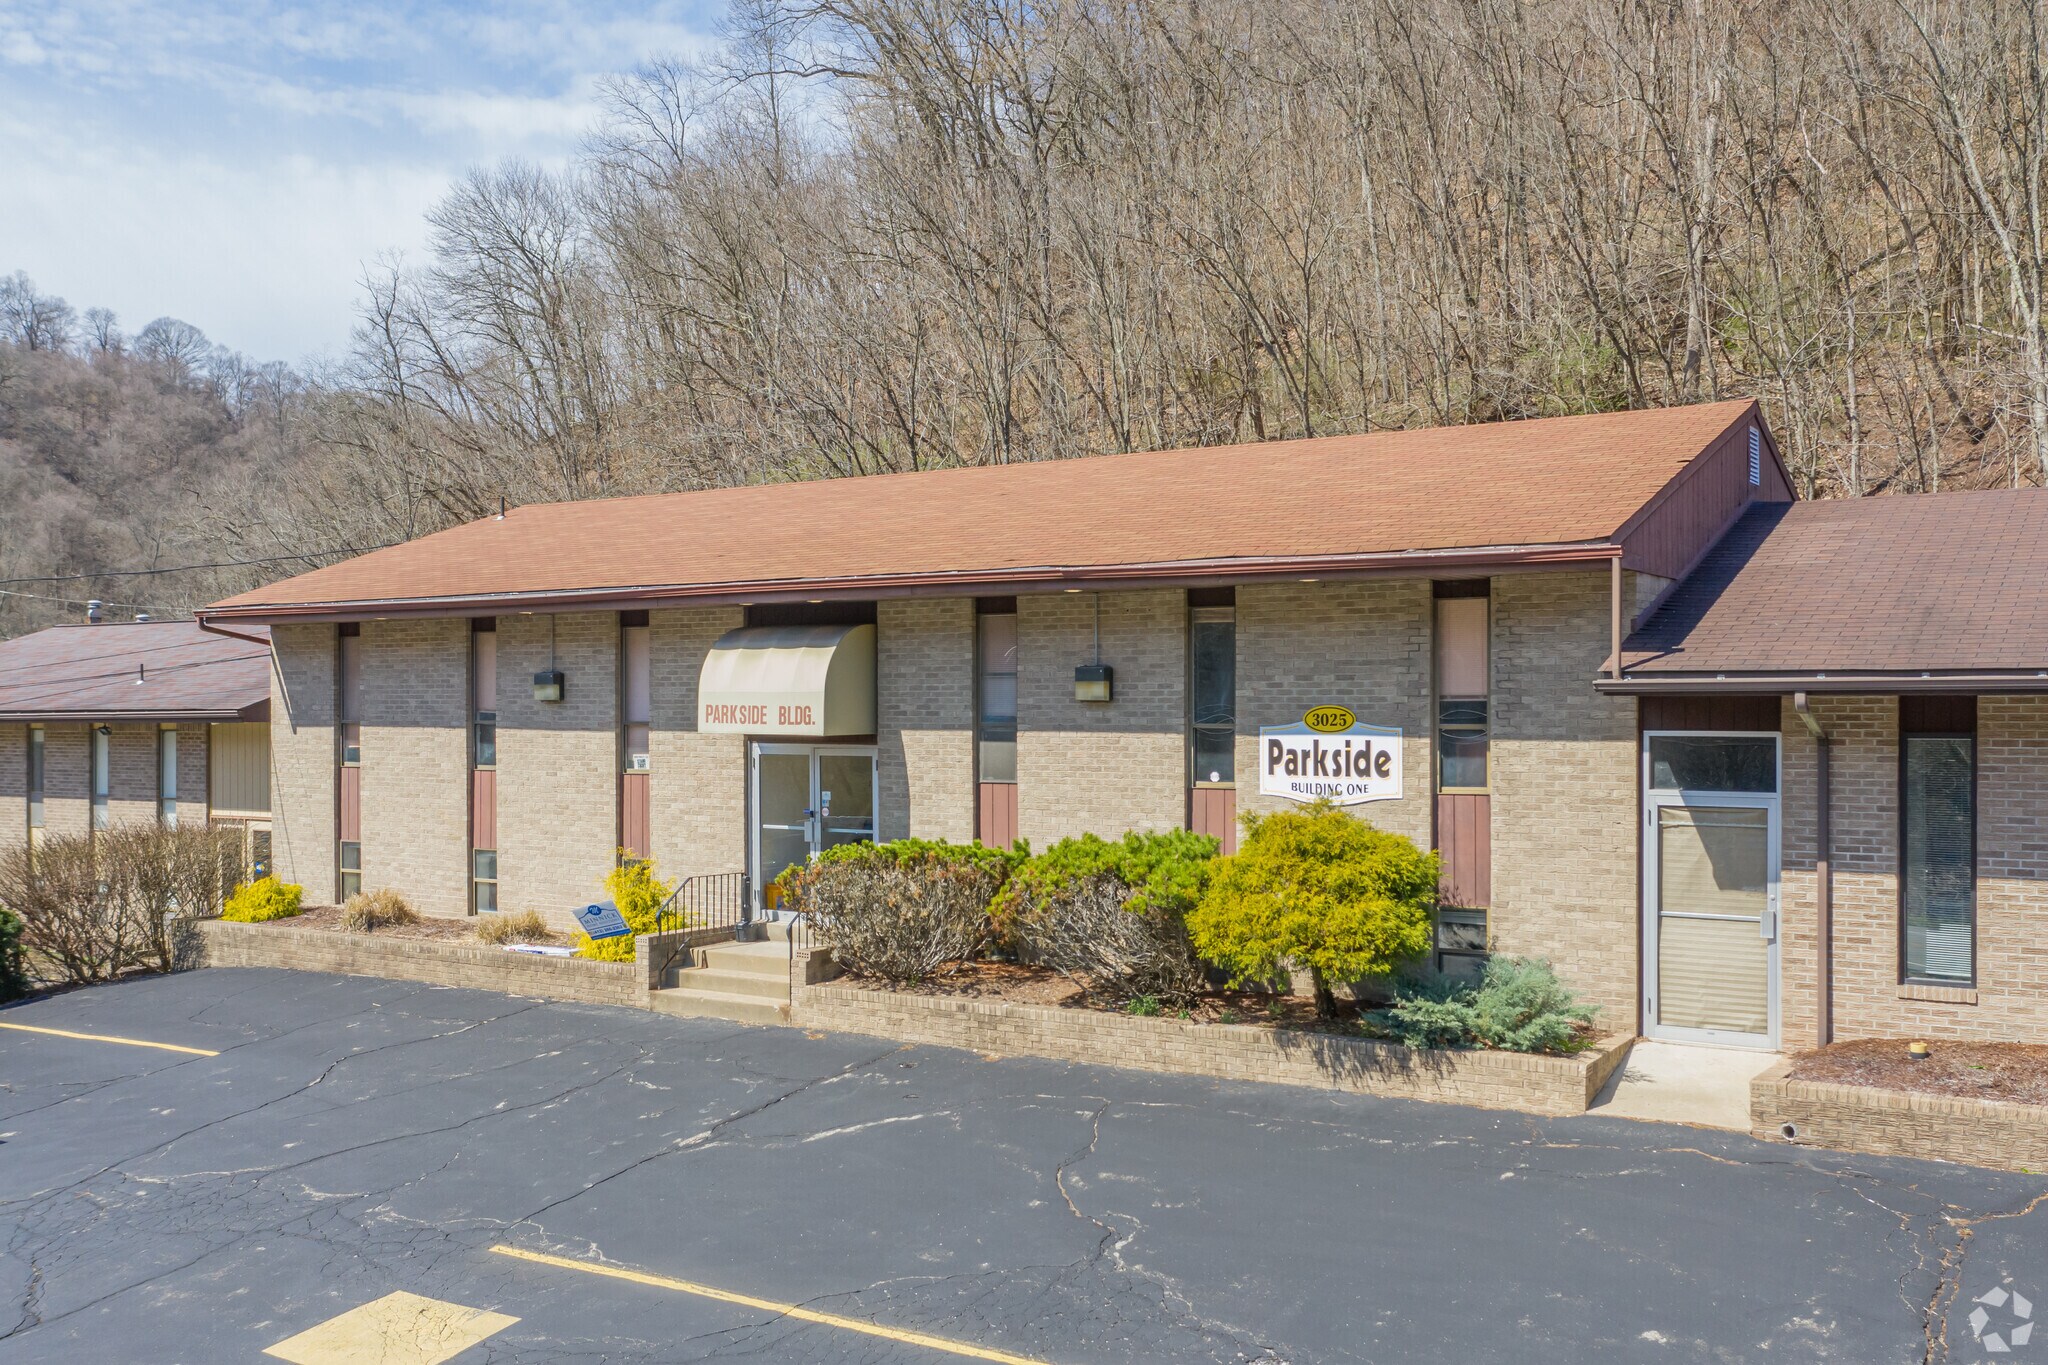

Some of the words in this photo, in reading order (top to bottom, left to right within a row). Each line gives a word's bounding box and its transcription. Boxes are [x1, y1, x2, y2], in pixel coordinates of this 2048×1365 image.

[705, 704, 768, 725] PARKSIDE
[778, 705, 816, 726] BLDG.
[1312, 713, 1347, 727] 3025
[1268, 738, 1392, 778] Parkside
[1291, 782, 1343, 796] BUILDING
[1347, 783, 1369, 796] ONE
[584, 912, 618, 924] MINNICK
